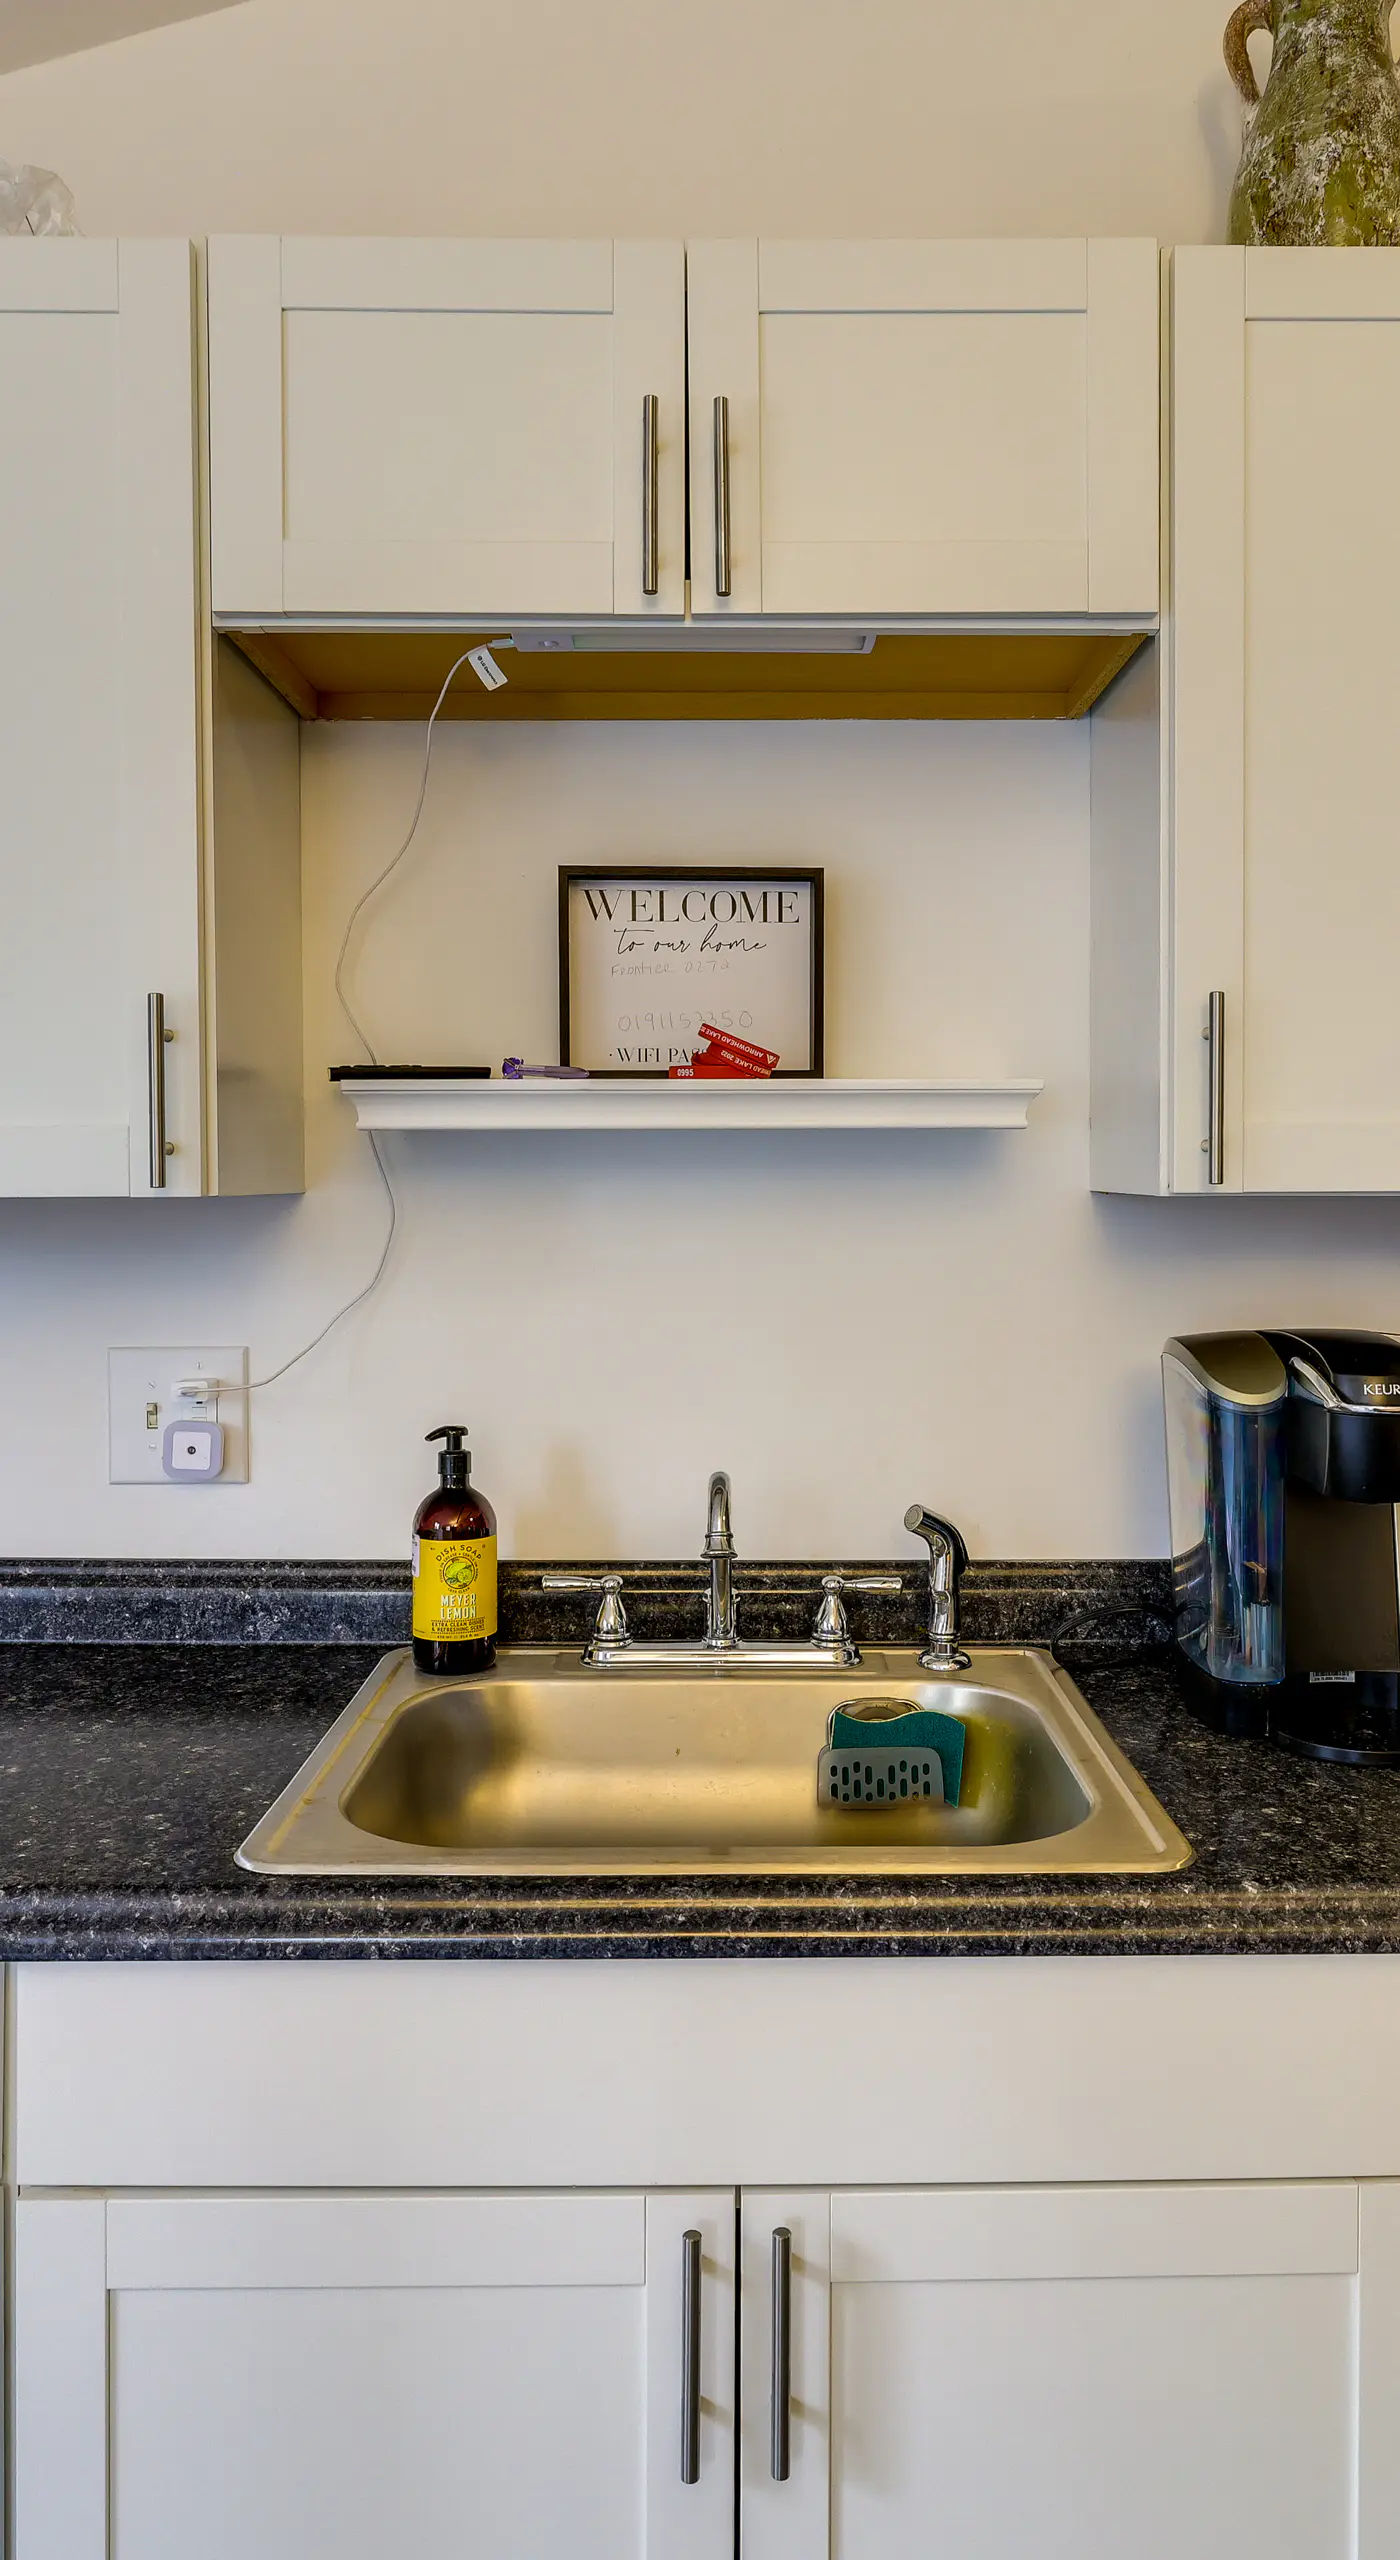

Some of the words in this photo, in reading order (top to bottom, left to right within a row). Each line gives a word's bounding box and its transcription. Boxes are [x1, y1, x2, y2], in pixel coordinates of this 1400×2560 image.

[580, 888, 800, 924] WELCOME
[613, 927, 655, 955] to
[653, 940, 691, 953] our
[699, 923, 767, 953] home
[706, 1028, 721, 1040] LAKE
[721, 1035, 764, 1058] ARROWHEAD
[617, 1048, 660, 1062] WIFI
[668, 1048, 708, 1062] PA
[720, 1050, 735, 1061] 2022
[734, 1057, 753, 1070] LAKE
[677, 1068, 694, 1077] 0995
[435, 1545, 456, 1561] DISH
[460, 1544, 482, 1560] SOAP
[440, 1594, 477, 1607] MEYER
[440, 1606, 477, 1620] LEMON
[470, 1623, 485, 1631] SCENT
